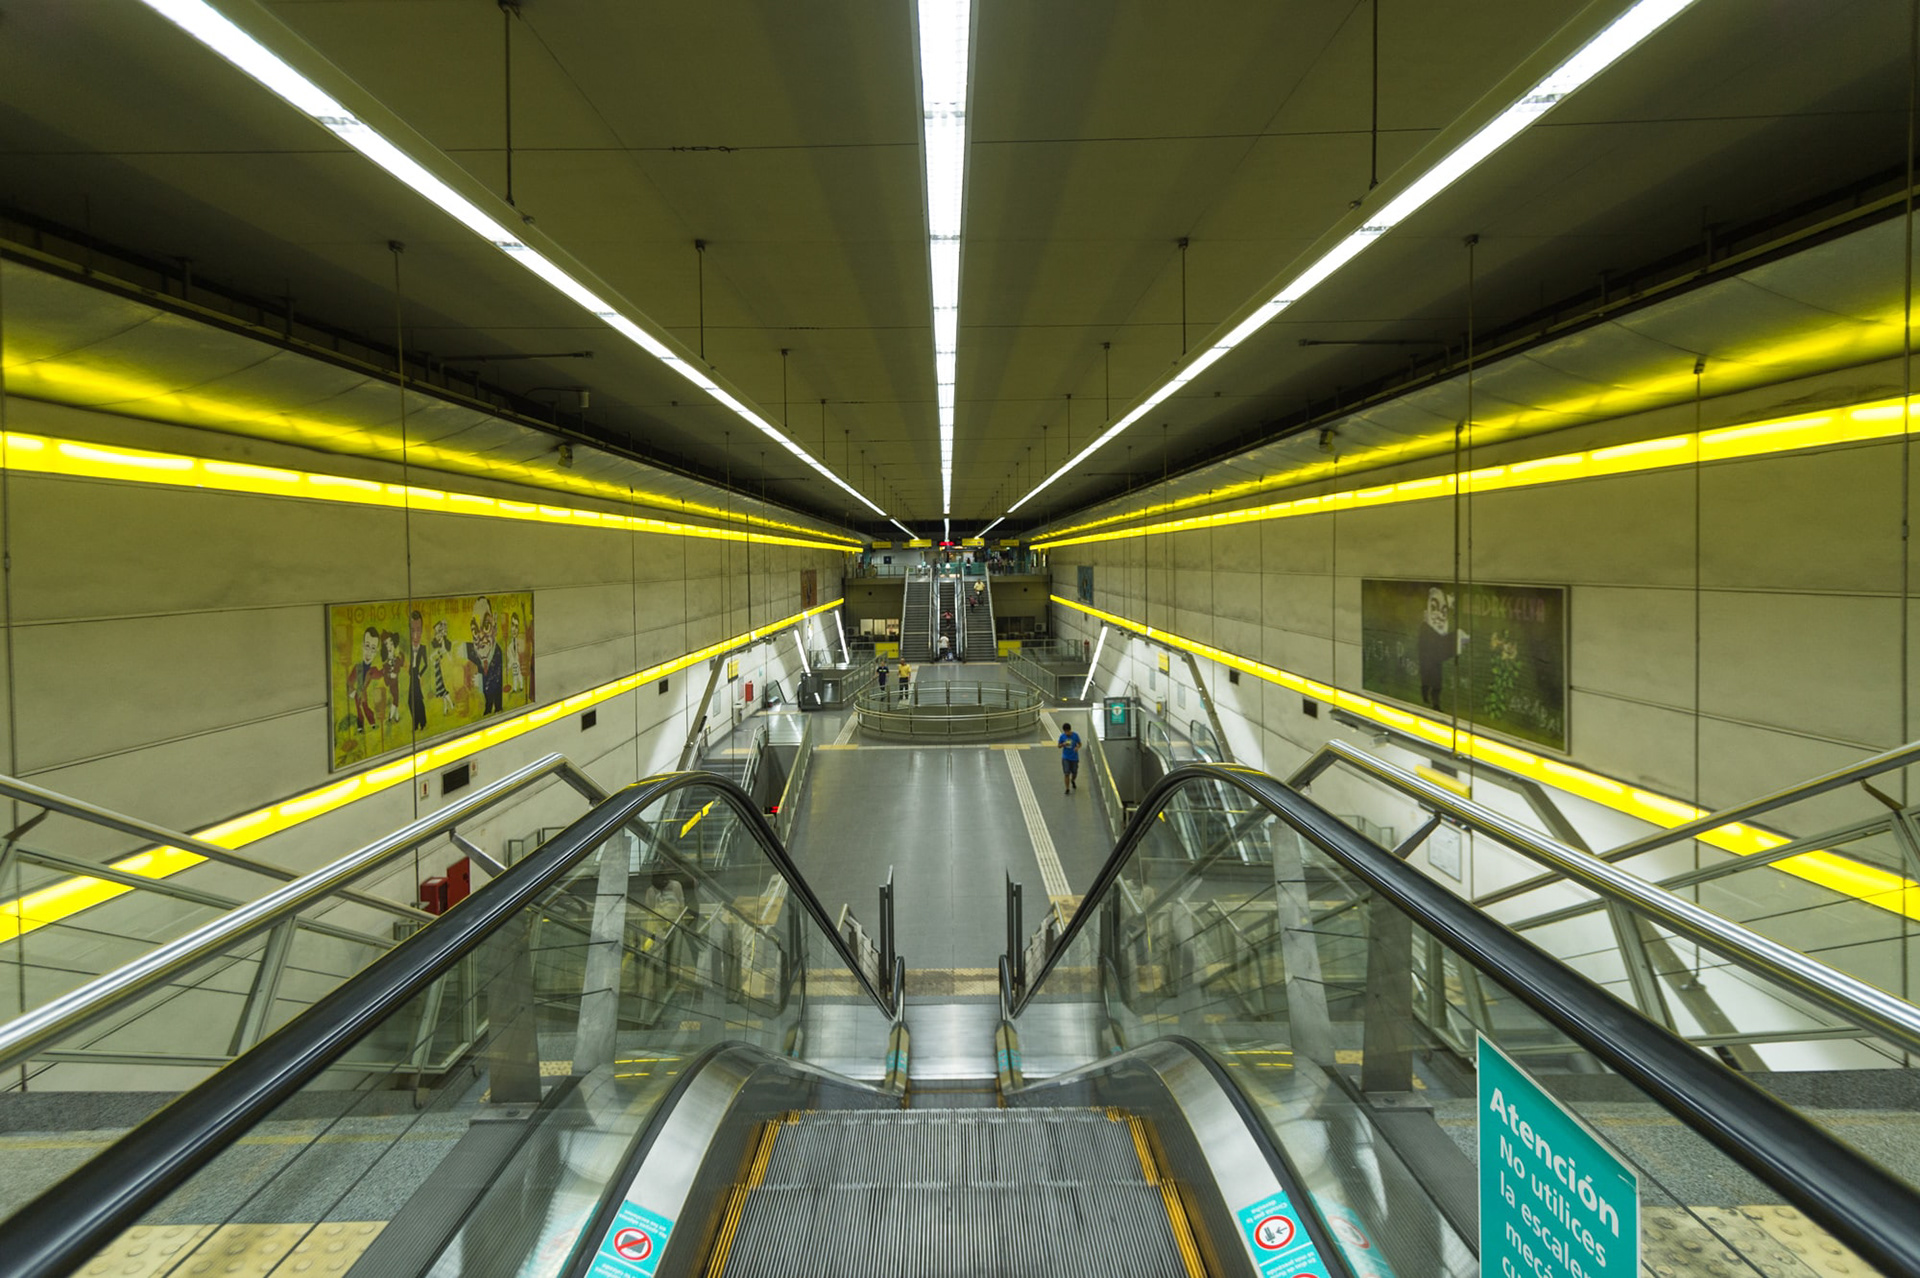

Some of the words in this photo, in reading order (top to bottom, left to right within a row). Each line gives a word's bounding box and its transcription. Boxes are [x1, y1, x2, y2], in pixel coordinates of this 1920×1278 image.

[1490, 1087, 1619, 1238] Atención
[1500, 1170, 1516, 1209] la
[1500, 1134, 1526, 1179] No
[1531, 1173, 1607, 1268] utilices
